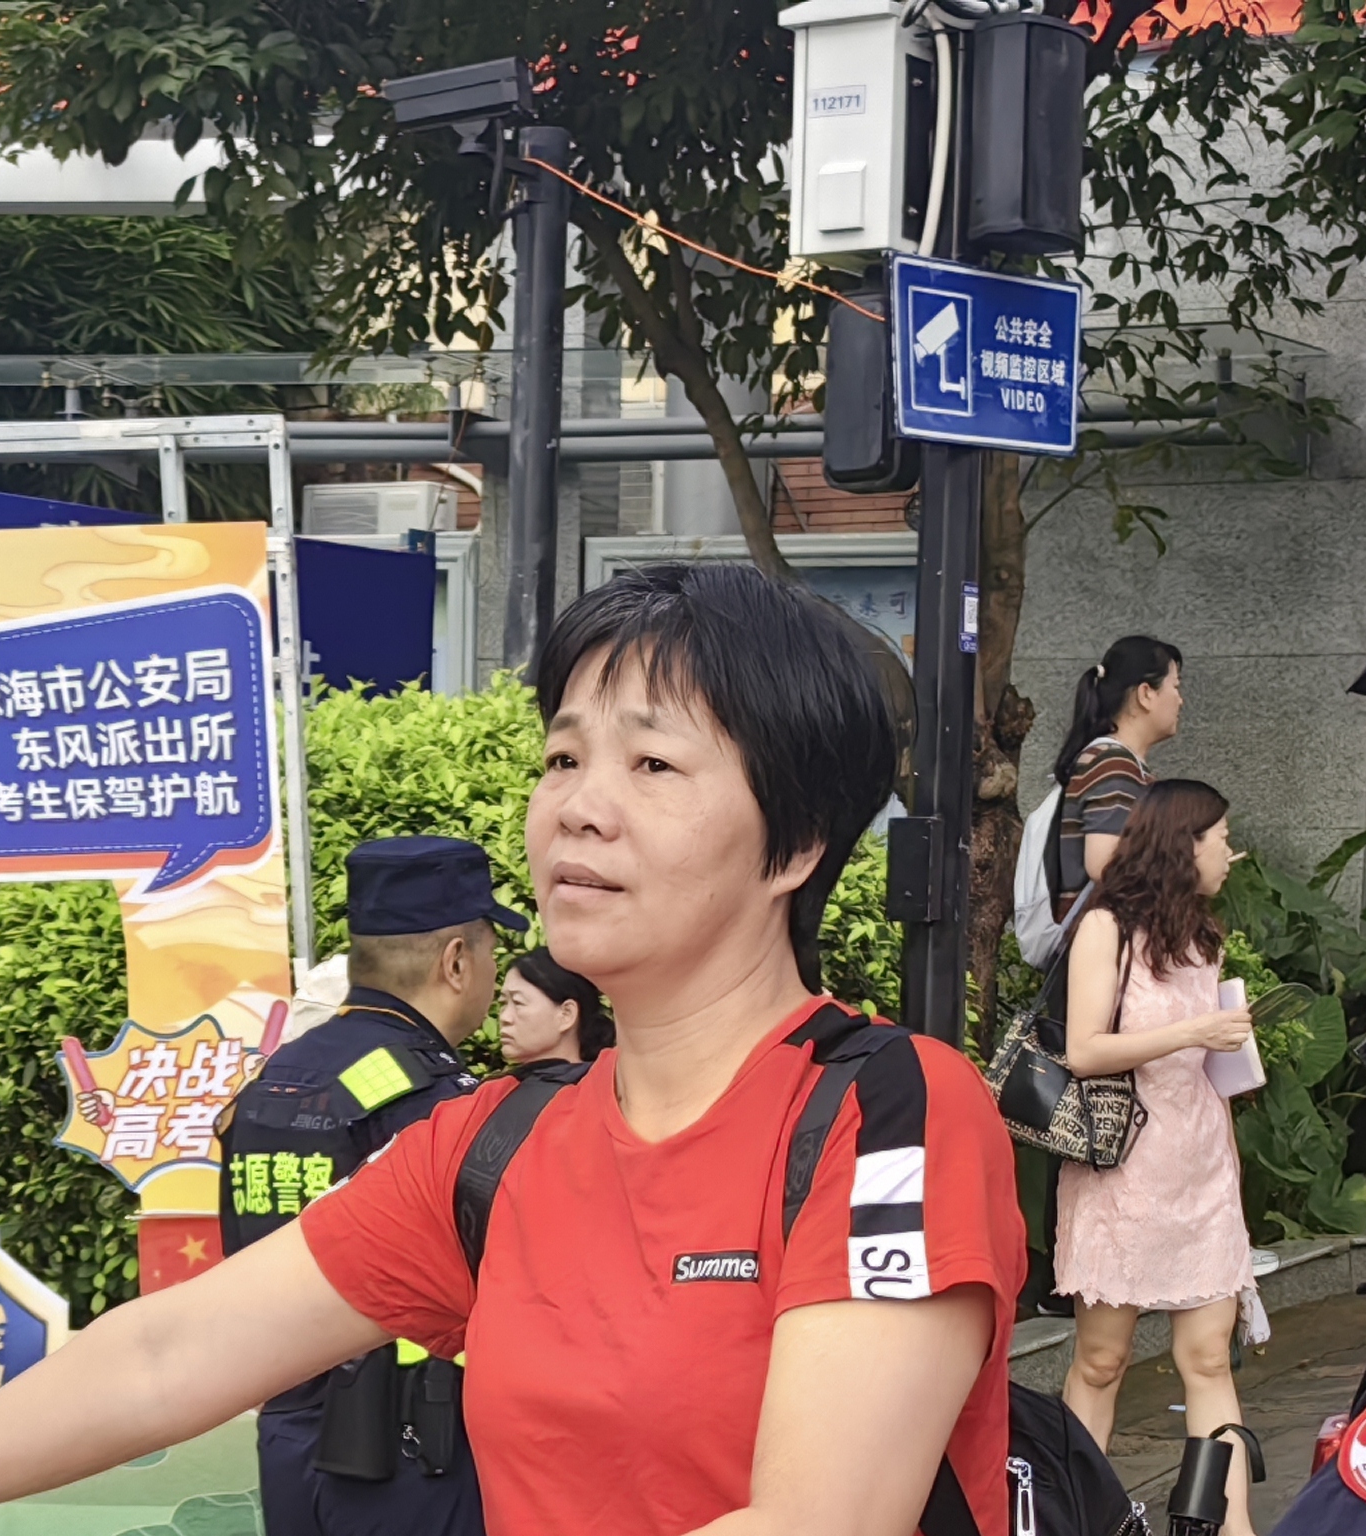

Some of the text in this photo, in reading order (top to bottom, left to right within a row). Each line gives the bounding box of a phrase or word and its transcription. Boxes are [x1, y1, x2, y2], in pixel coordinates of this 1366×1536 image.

[812, 93, 861, 112] 112171
[994, 315, 1053, 349] 公共安全
[980, 348, 1066, 386] 视频监控区域
[1000, 388, 1045, 413] VIDEO
[11, 711, 237, 773] 东风派出所
[116, 1040, 242, 1100] 决战
[101, 1102, 223, 1162] 高考
